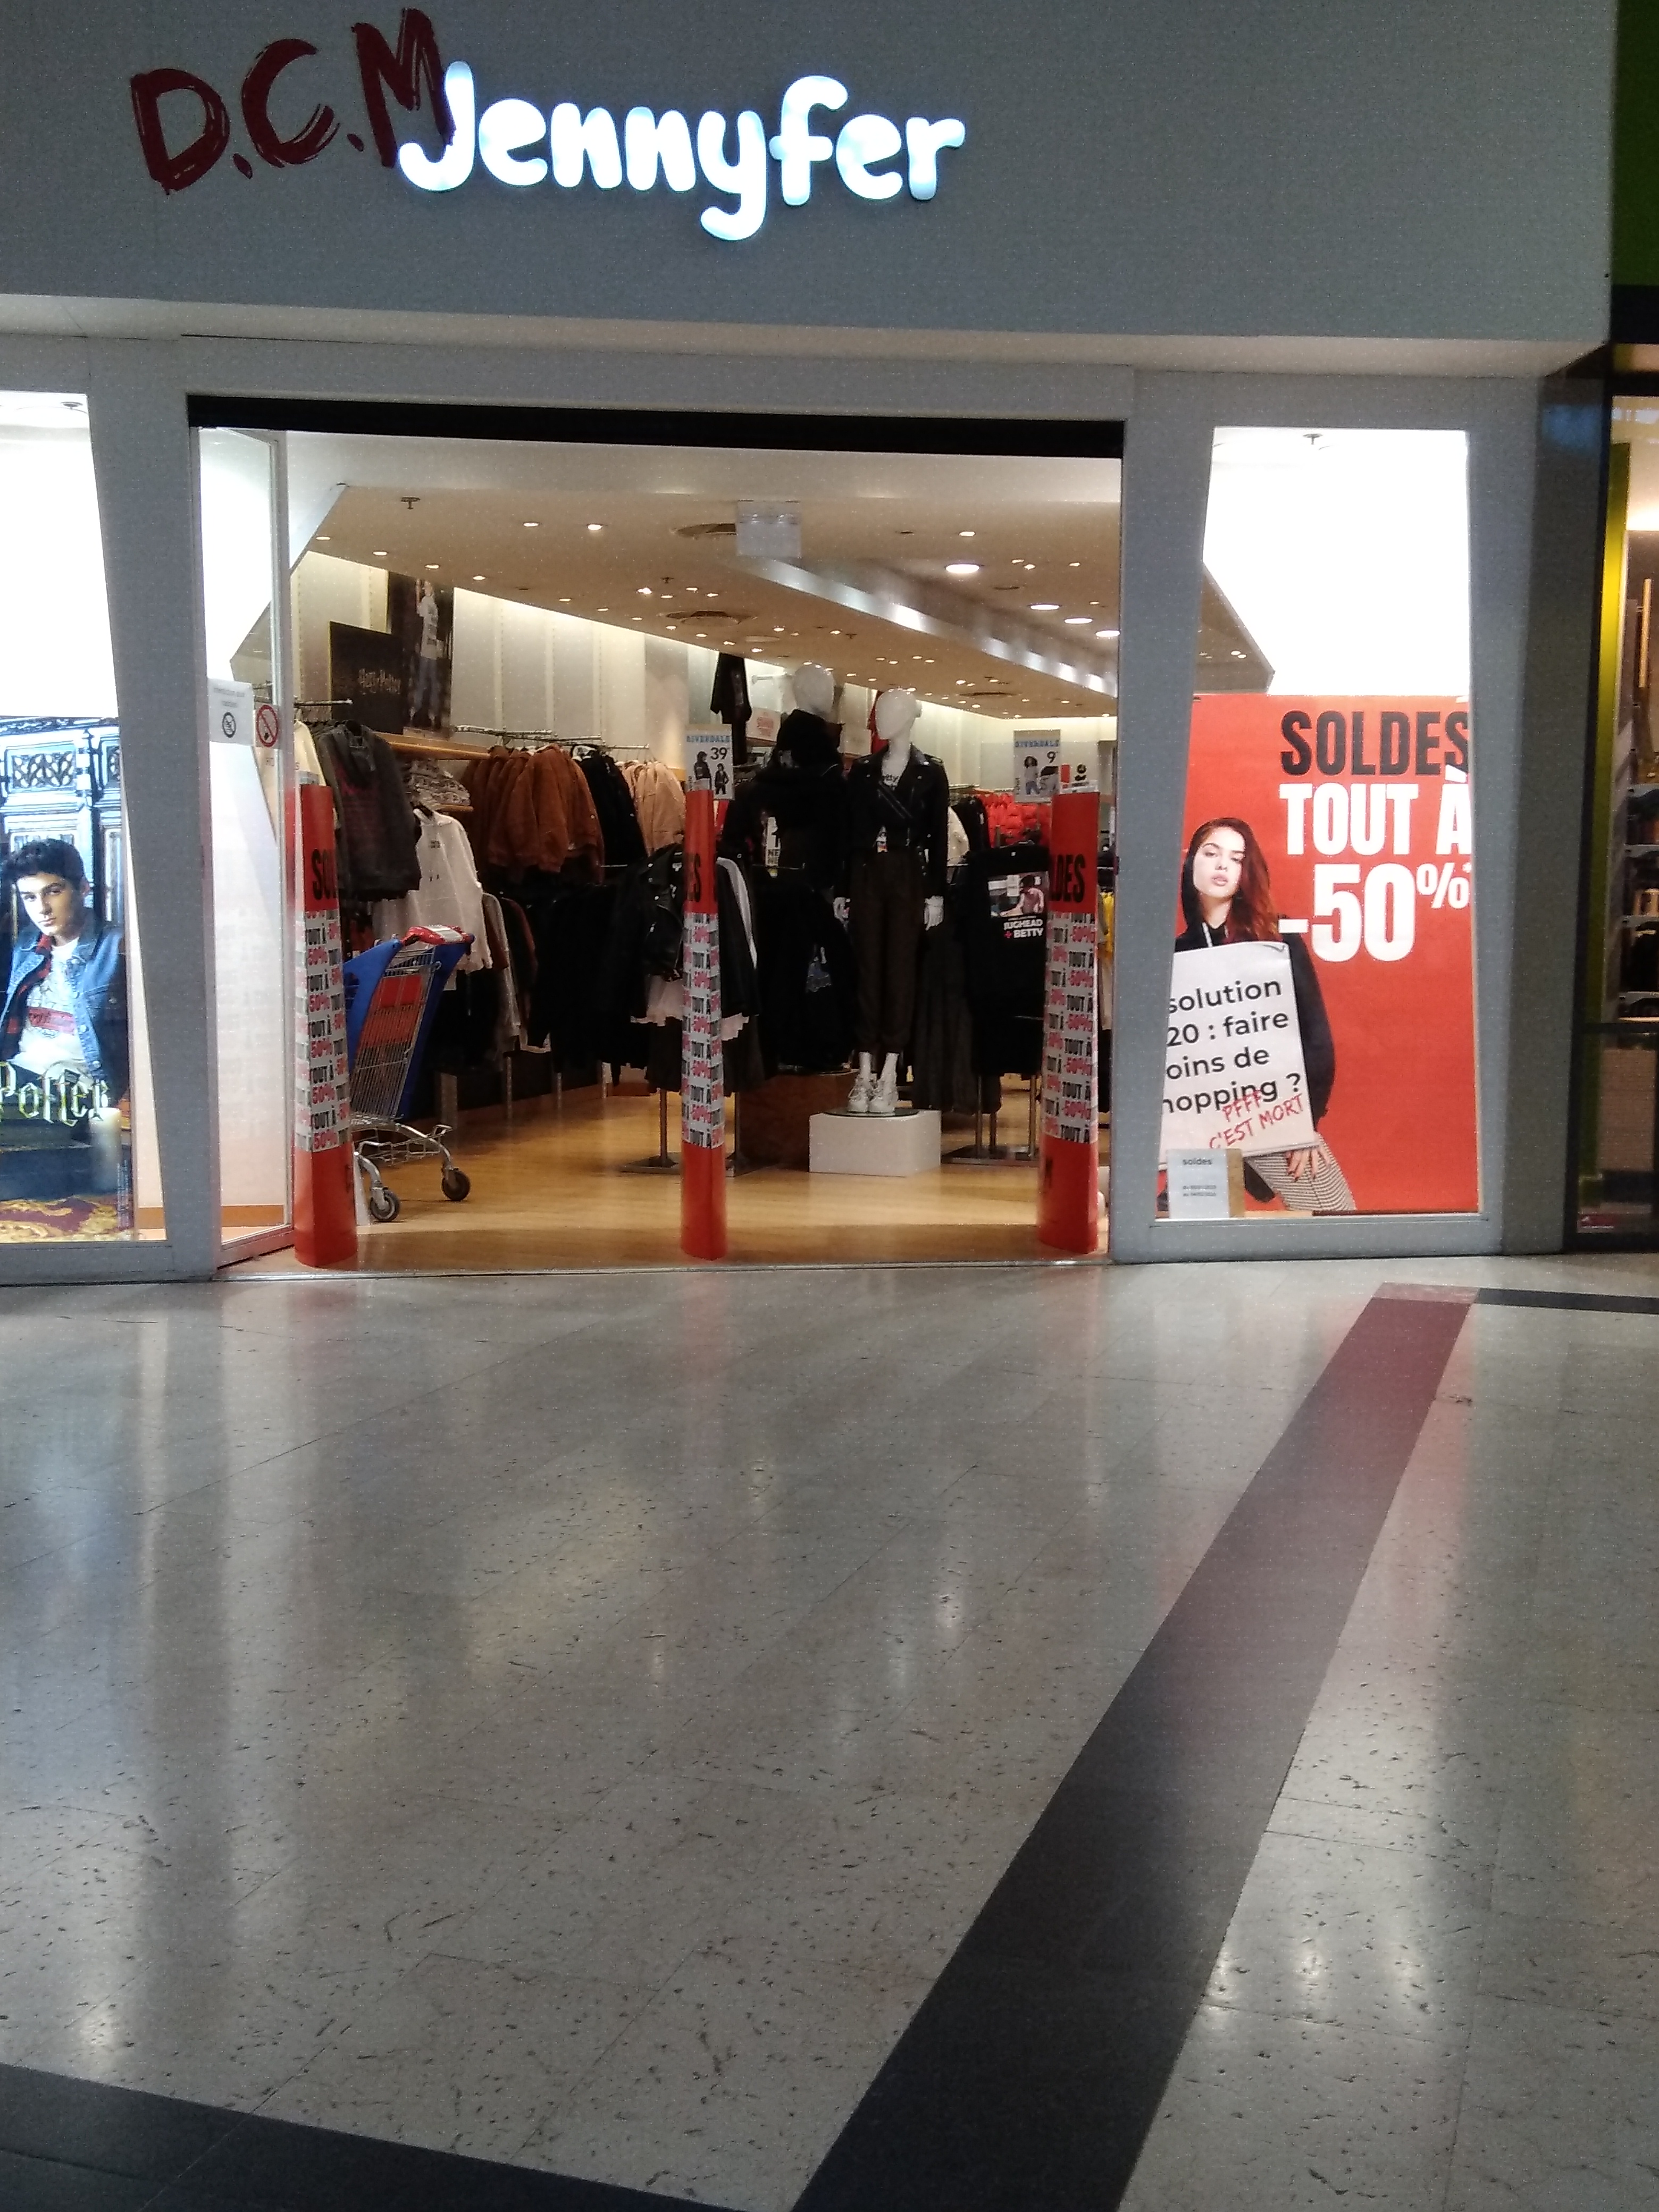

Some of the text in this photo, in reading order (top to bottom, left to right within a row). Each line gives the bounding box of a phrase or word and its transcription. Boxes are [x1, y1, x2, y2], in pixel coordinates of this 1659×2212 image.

[398, 60, 966, 241] Jennyfer
[710, 747, 728, 760] 39
[1280, 711, 1469, 776] SOLDES
[1279, 764, 1471, 856] TOUT À
[1003, 919, 1043, 931] JUGHEAD
[1013, 928, 1044, 939] BETTY
[1223, 1011, 1288, 1037] faire
[1167, 1046, 1269, 1079] oins de
[1209, 1093, 1303, 1149] C'EST MORT
[1223, 1088, 1261, 1122] PFFF
